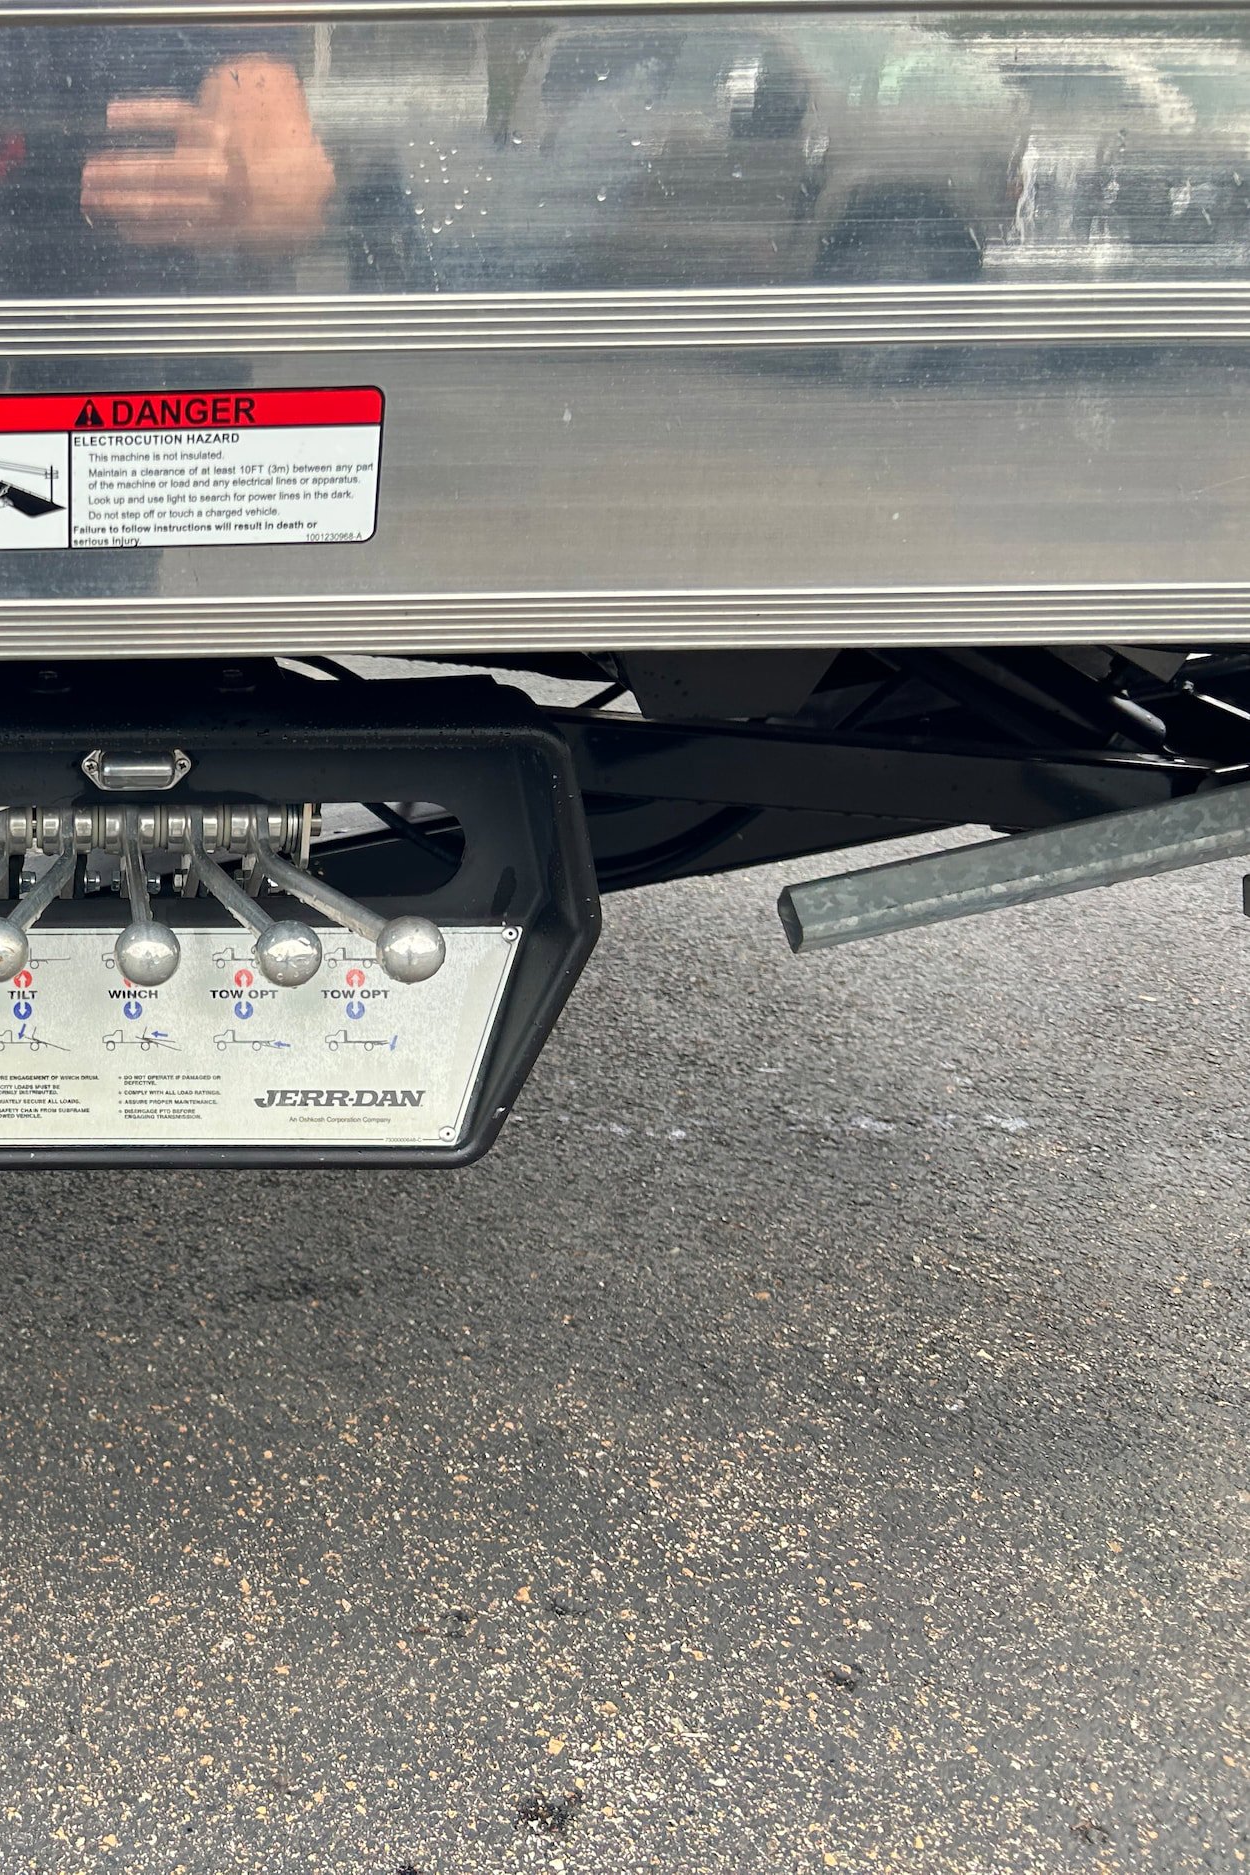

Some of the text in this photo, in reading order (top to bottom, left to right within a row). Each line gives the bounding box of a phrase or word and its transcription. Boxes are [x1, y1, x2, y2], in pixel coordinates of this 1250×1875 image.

[112, 398, 255, 426] DANGER
[74, 433, 240, 447] ELECTROCUTION HAZARD
[89, 451, 224, 462] This machine is not insulated.
[88, 462, 374, 478] Maintain a clearance of at least 10FT (3m) between any part
[88, 476, 360, 490] of the machine or load and any electrical lines or apparatus.
[88, 490, 354, 507] Look up and use light to search for power lines in the dark.
[88, 507, 280, 522] Do not step off or touch a charged vehicle.
[73, 520, 318, 535] Failure to follow instructions will result in death or
[73, 536, 142, 547] serious injury.
[7, 990, 38, 1000] TILT
[108, 989, 158, 999] WINCH
[210, 989, 278, 999] TOW OPT
[320, 989, 390, 999] TOW OPT
[254, 1089, 426, 1108] JERR-DAN
[326, 1116, 361, 1124] Corporation
[362, 1116, 391, 1124] Company
